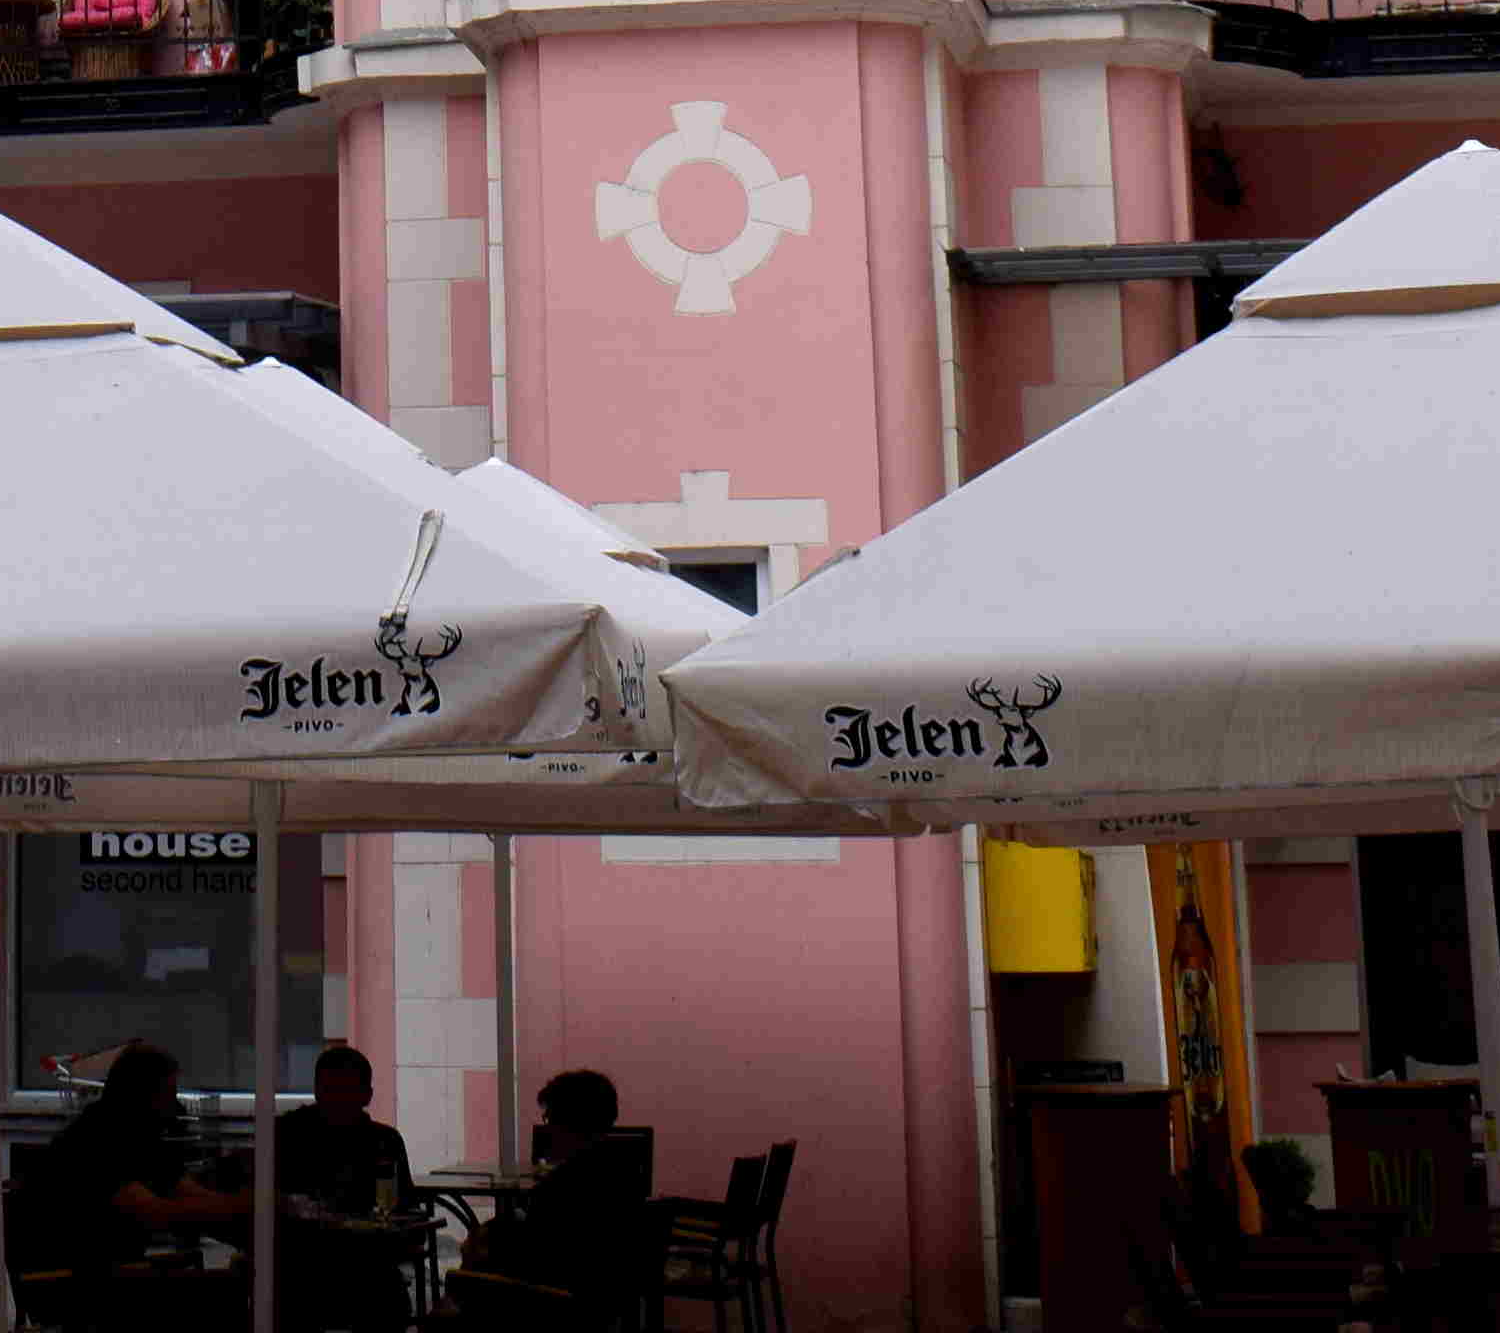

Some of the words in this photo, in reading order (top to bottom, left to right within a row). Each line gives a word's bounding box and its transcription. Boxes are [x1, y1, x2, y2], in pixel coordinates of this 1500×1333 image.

[240, 656, 383, 722] Jelen
[824, 704, 985, 770] Jelen
[81, 866, 183, 894] second
